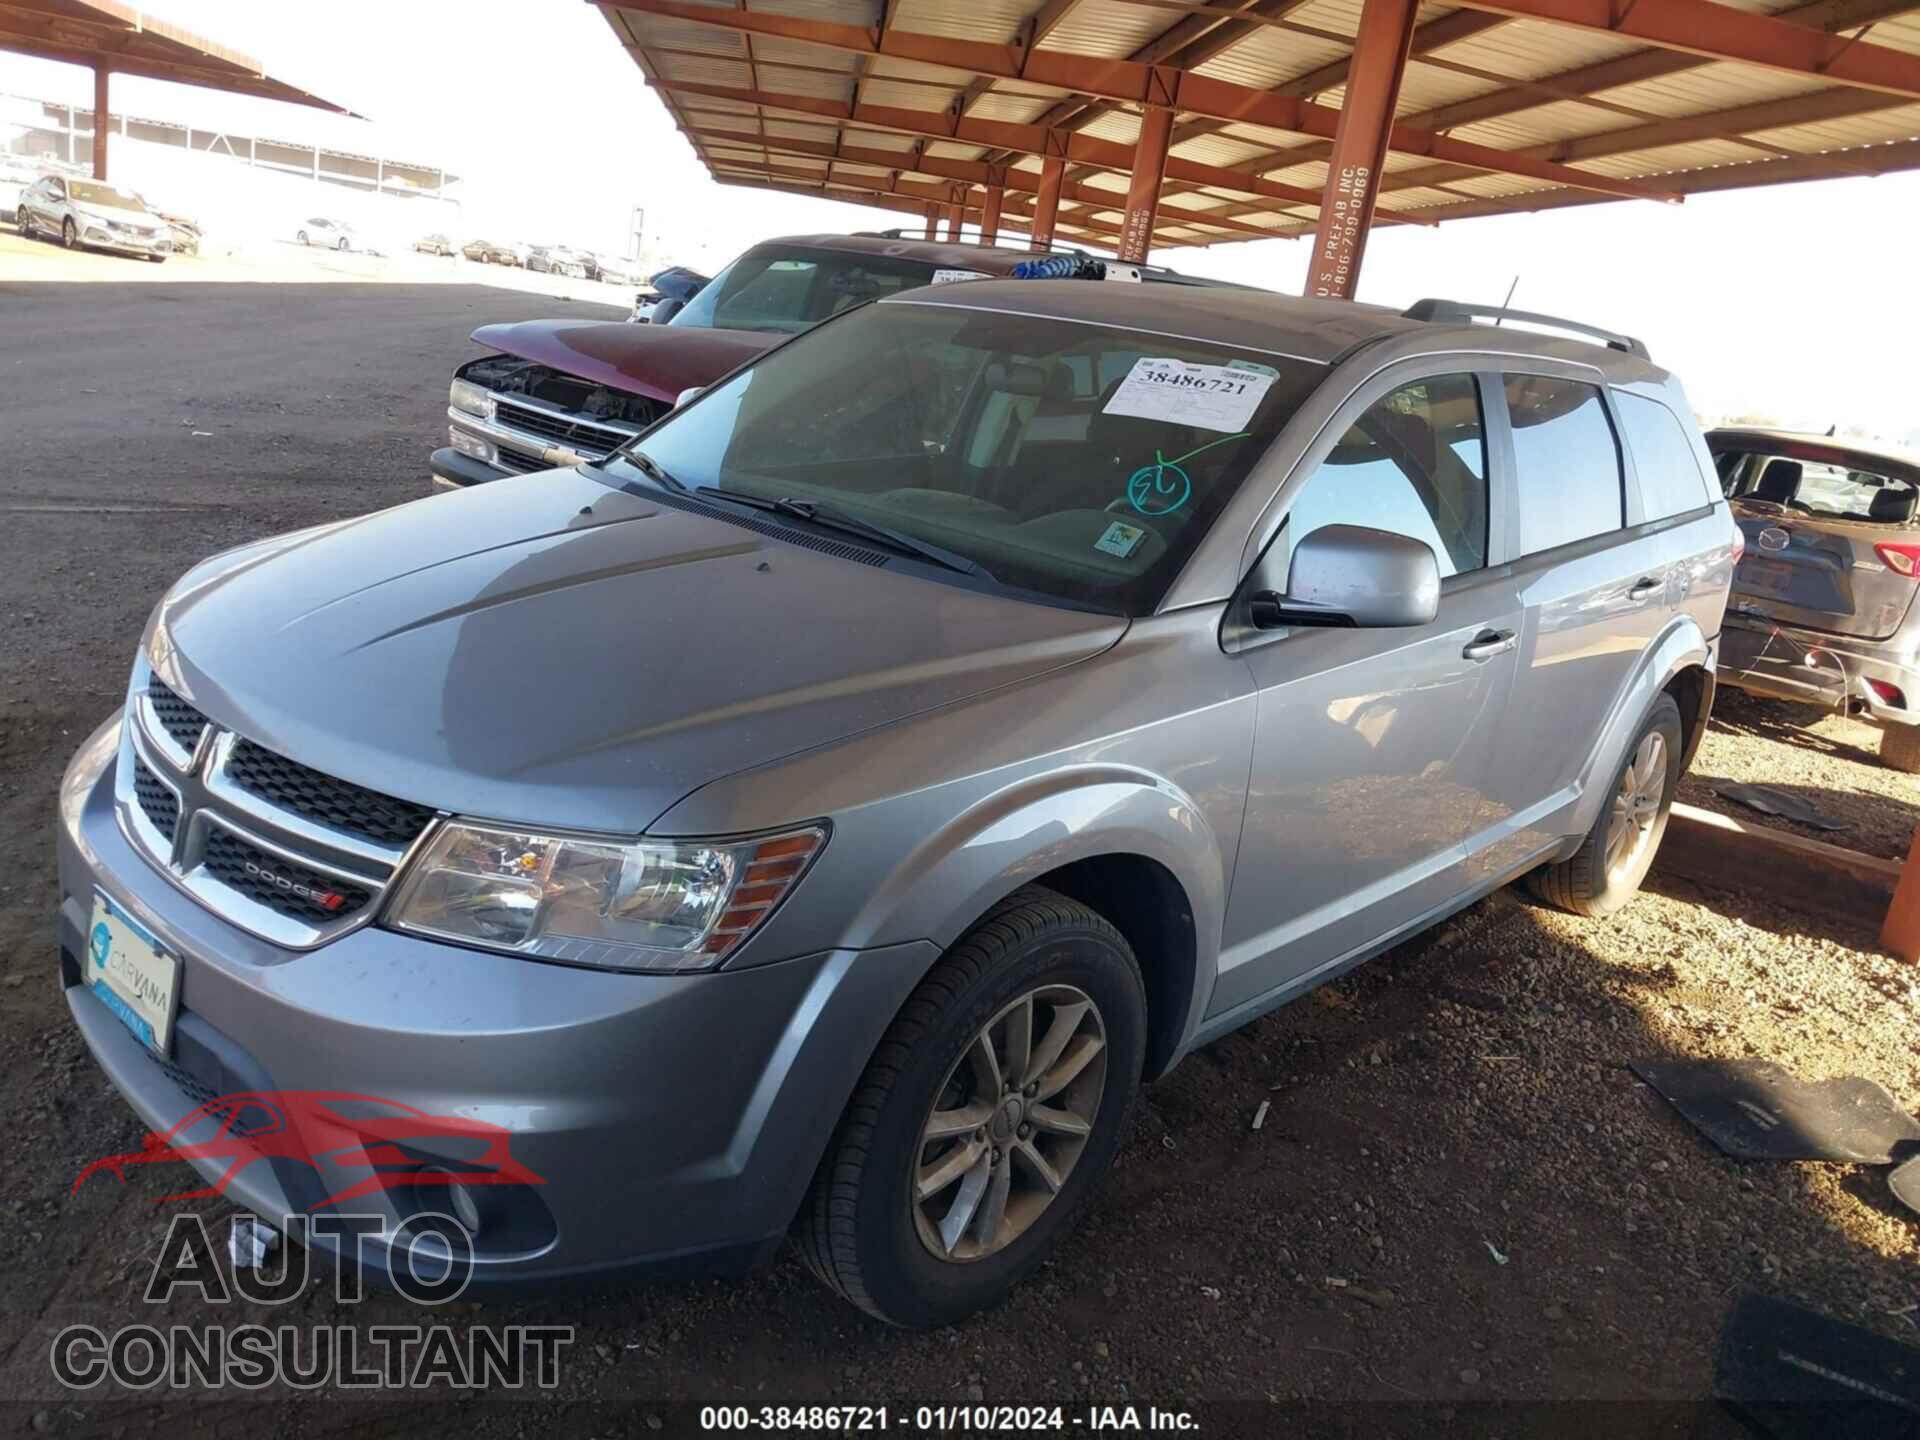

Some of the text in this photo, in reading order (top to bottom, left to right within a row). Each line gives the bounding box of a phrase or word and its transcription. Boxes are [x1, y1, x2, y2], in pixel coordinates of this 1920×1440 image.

[1325, 200, 1347, 260] PREFAB
[1339, 164, 1356, 193] INC.
[1139, 370, 1247, 395] 38486721
[245, 862, 328, 904] DODGE
[109, 950, 167, 1011] CARVANA
